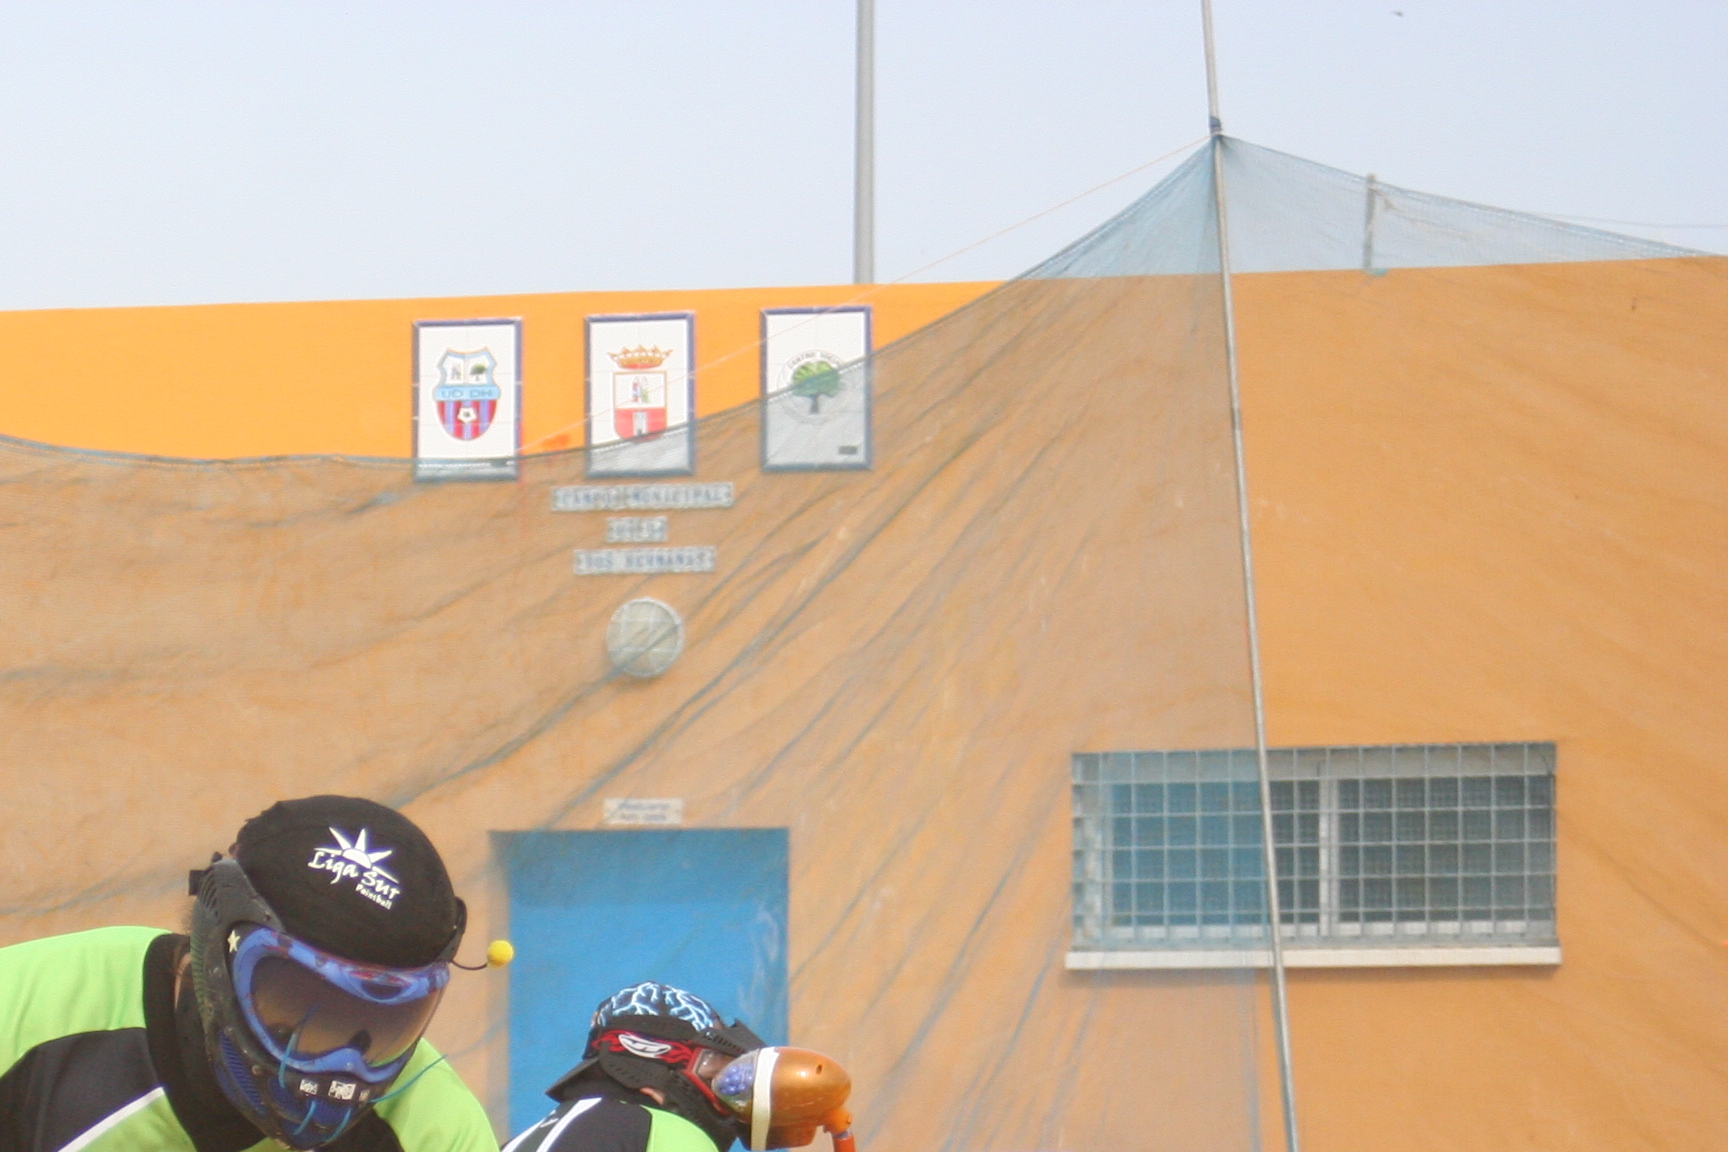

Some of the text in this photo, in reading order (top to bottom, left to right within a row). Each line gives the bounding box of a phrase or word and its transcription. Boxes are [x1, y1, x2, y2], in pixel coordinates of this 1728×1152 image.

[307, 851, 400, 899] Liga Sur
[355, 883, 393, 910] Paintball
